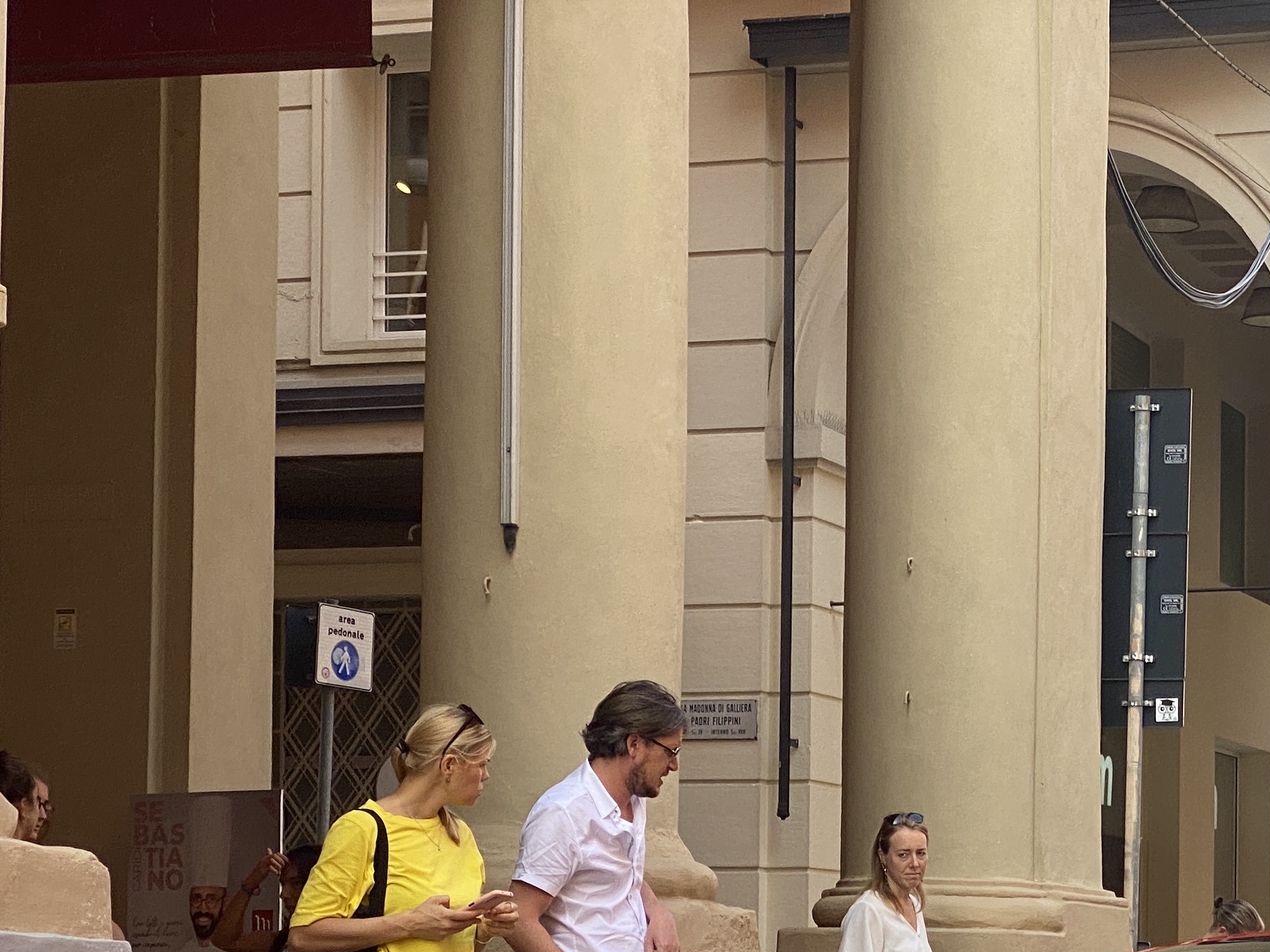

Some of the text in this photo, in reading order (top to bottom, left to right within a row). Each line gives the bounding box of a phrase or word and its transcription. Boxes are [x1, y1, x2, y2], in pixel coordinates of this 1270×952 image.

[339, 615, 355, 625] area
[328, 627, 365, 640] pedonale
[689, 704, 716, 713] MADONNA
[718, 704, 724, 713] DI
[726, 703, 752, 713] GALLIERA
[690, 716, 741, 726] PADRI FILIPPINI
[133, 801, 163, 823] SE
[133, 823, 186, 846] BAS
[144, 846, 183, 868] TIA
[147, 869, 184, 892] NO
